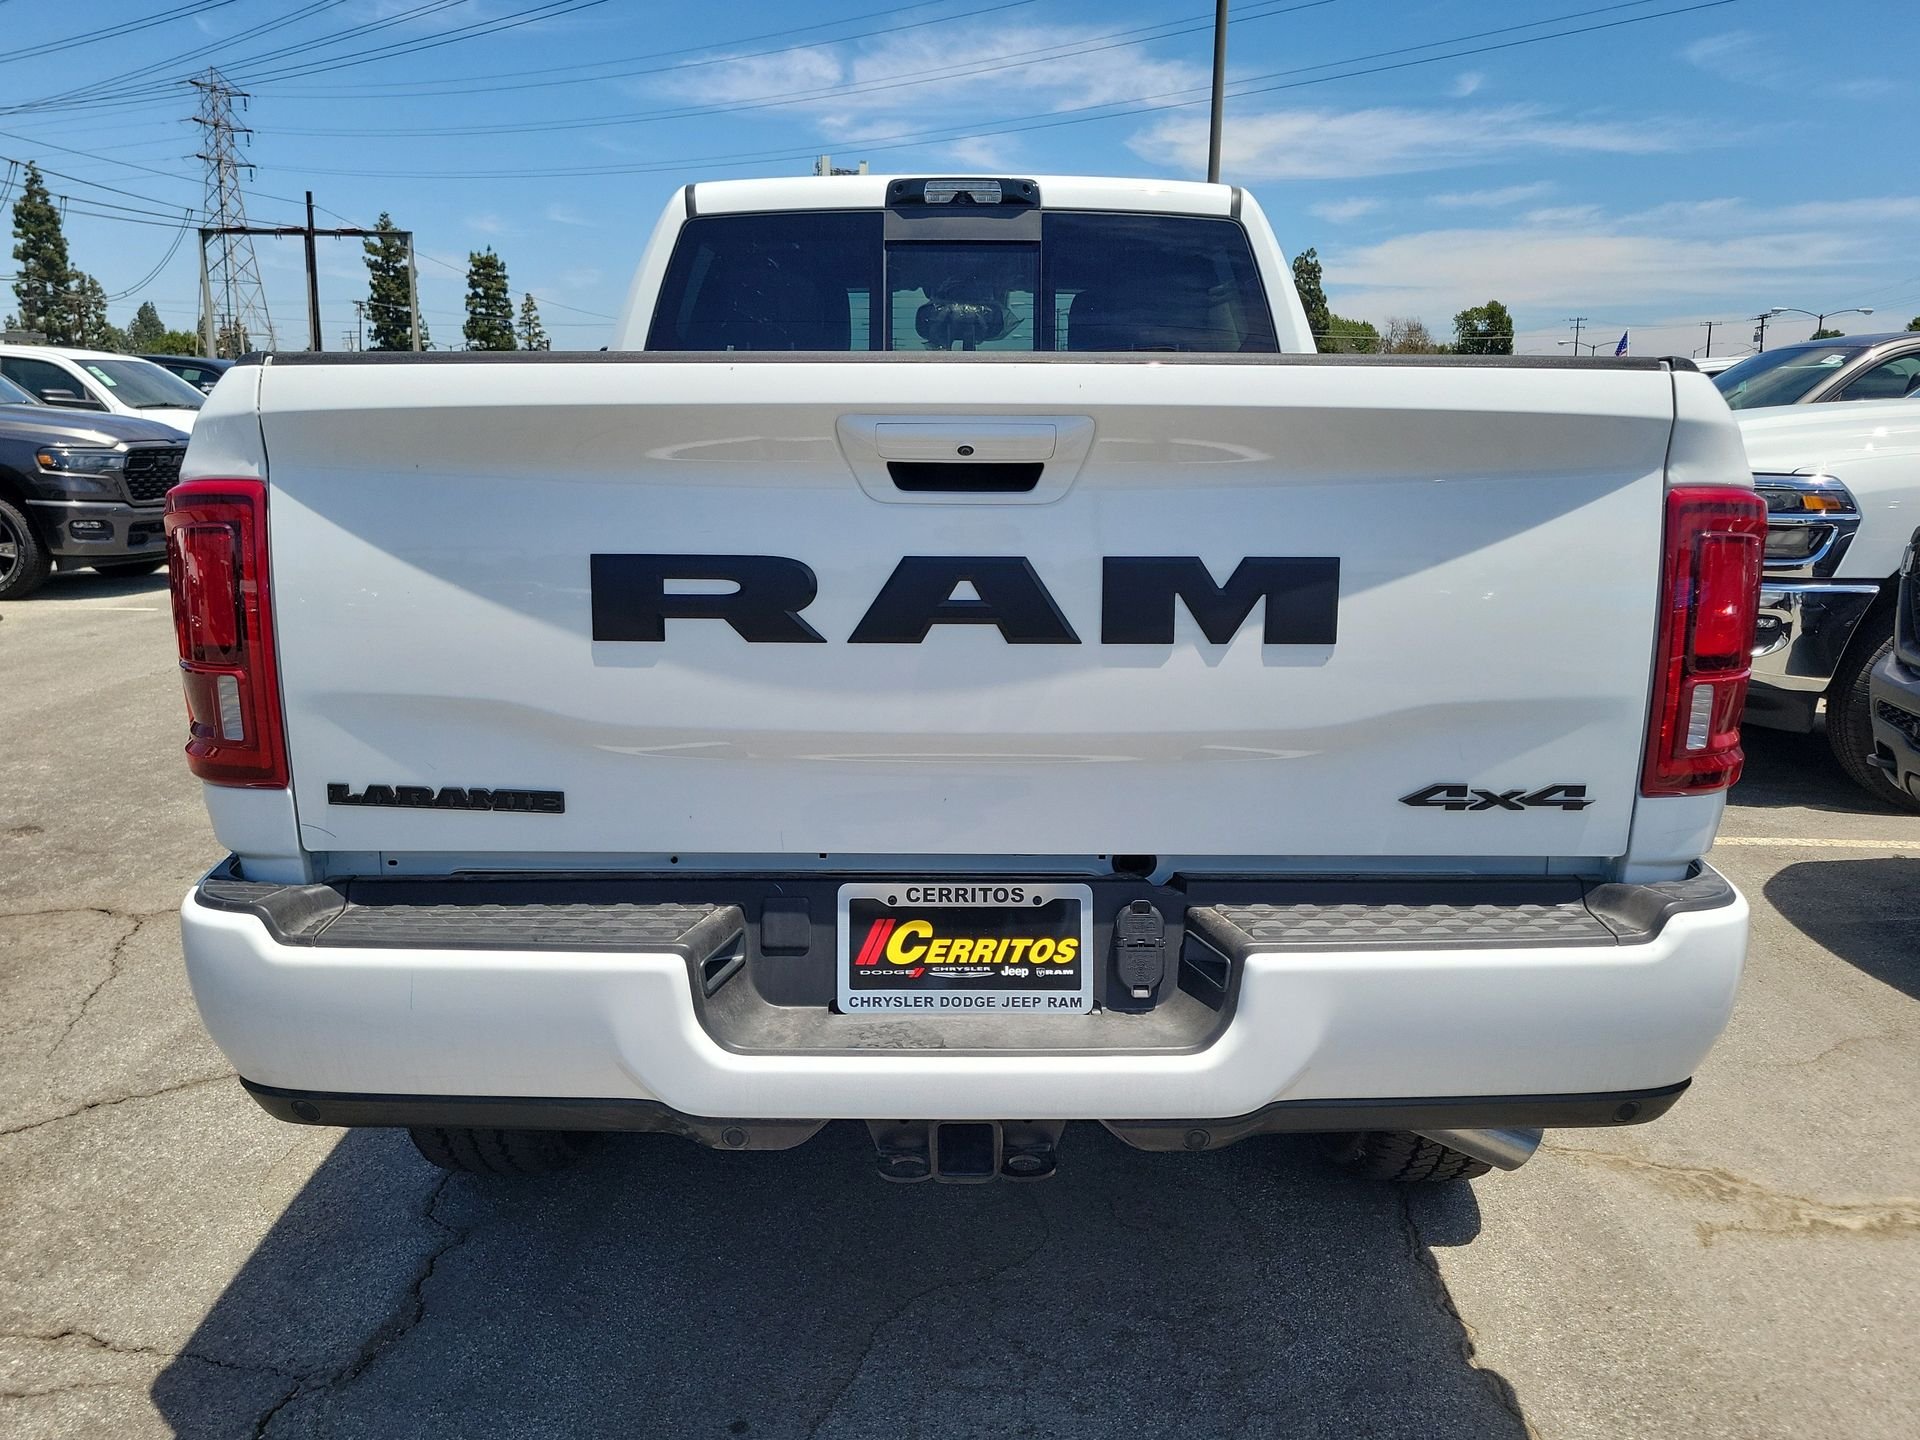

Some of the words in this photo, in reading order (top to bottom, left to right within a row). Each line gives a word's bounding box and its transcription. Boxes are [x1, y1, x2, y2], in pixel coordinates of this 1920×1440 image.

[590, 553, 1341, 645] RAM
[327, 783, 565, 814] LARAMIE
[1398, 783, 1596, 810] 4x4
[905, 887, 1025, 904] CERRITOS
[886, 919, 1079, 965] CERRITOS
[1001, 965, 1029, 978] Jeep
[849, 996, 934, 1008] CHRYSLER
[940, 996, 996, 1008] DODGE
[1001, 996, 1042, 1008] JEEP
[1047, 997, 1083, 1008] RAM
